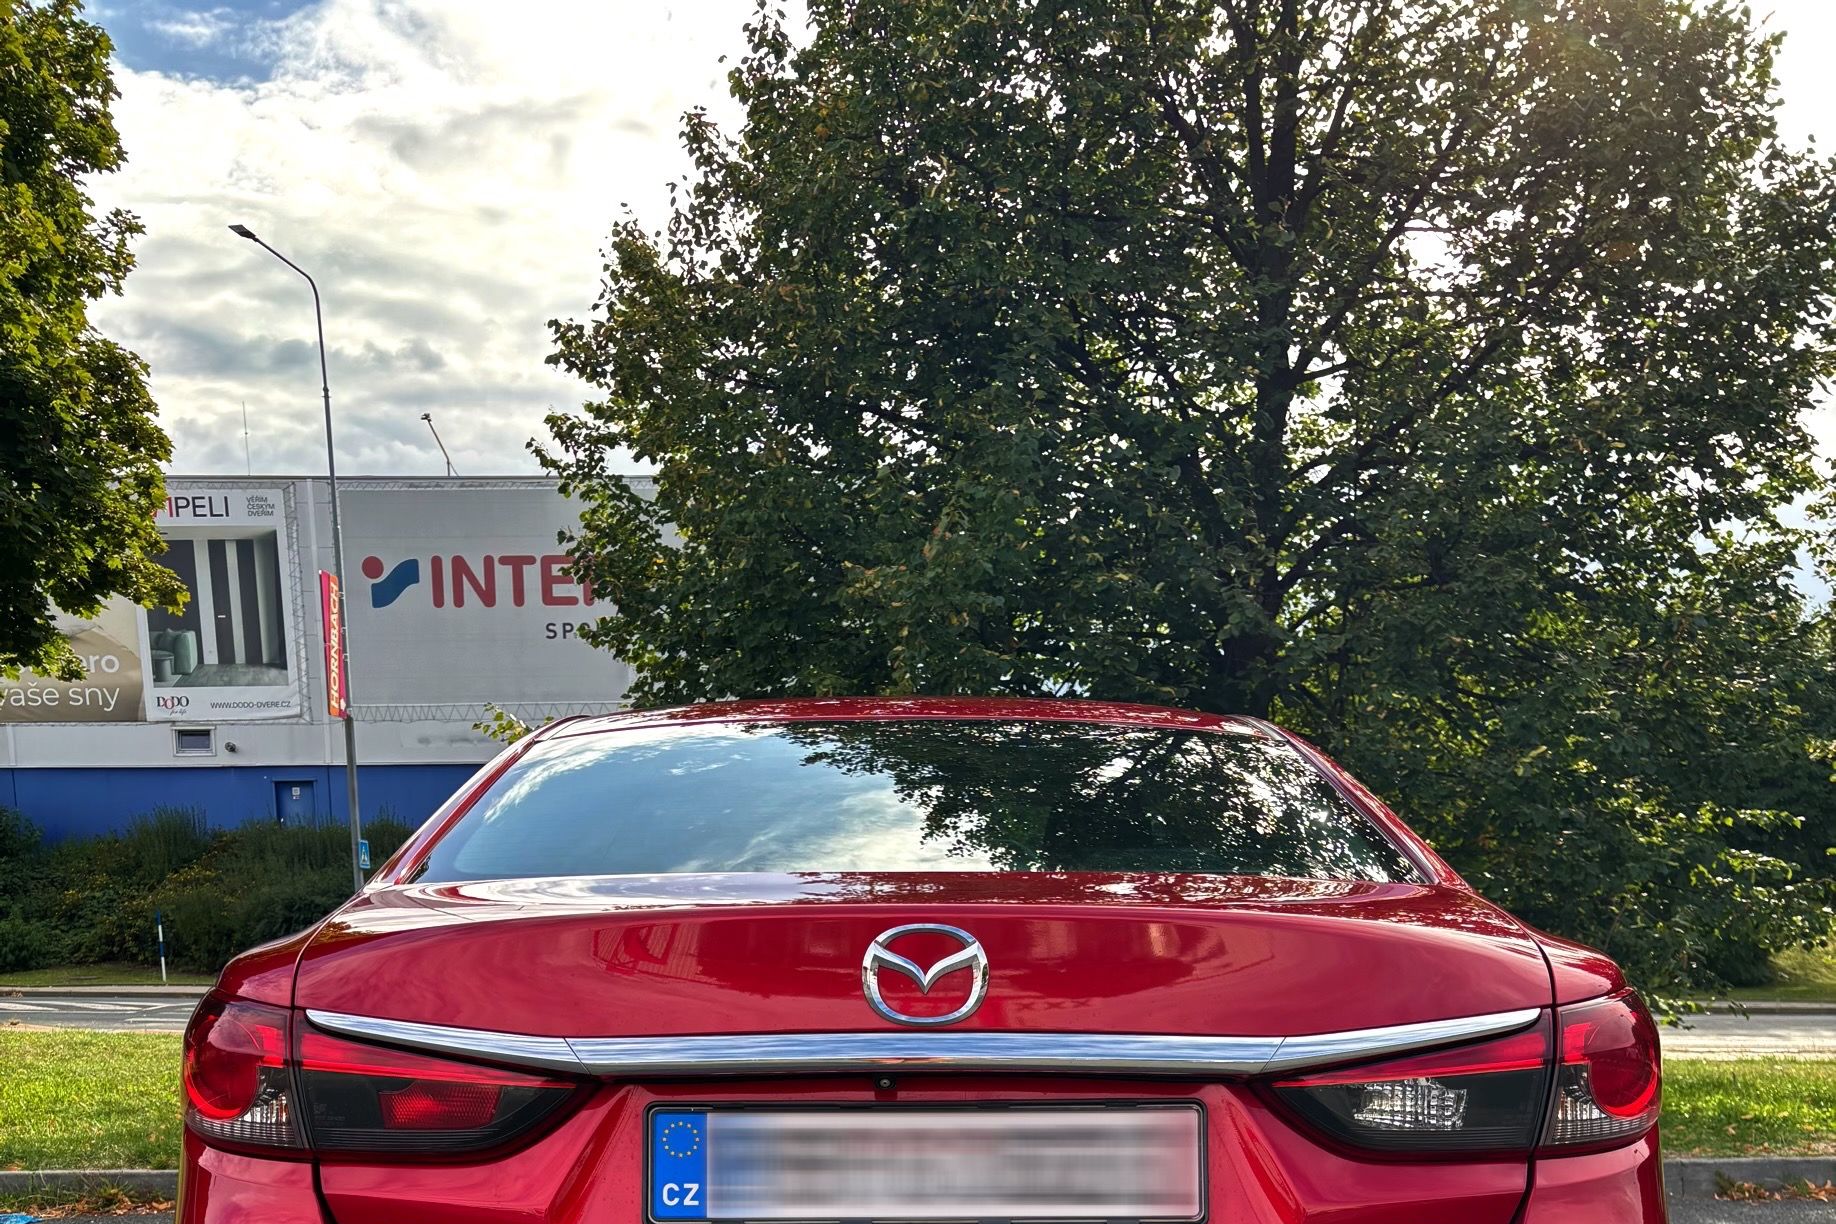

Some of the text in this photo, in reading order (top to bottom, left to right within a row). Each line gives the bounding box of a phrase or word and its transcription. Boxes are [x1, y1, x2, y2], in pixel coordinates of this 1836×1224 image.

[330, 582, 340, 708] HORNBACH
[69, 687, 120, 712] sny
[156, 696, 189, 709] DODO
[662, 1183, 700, 1206] CZ
